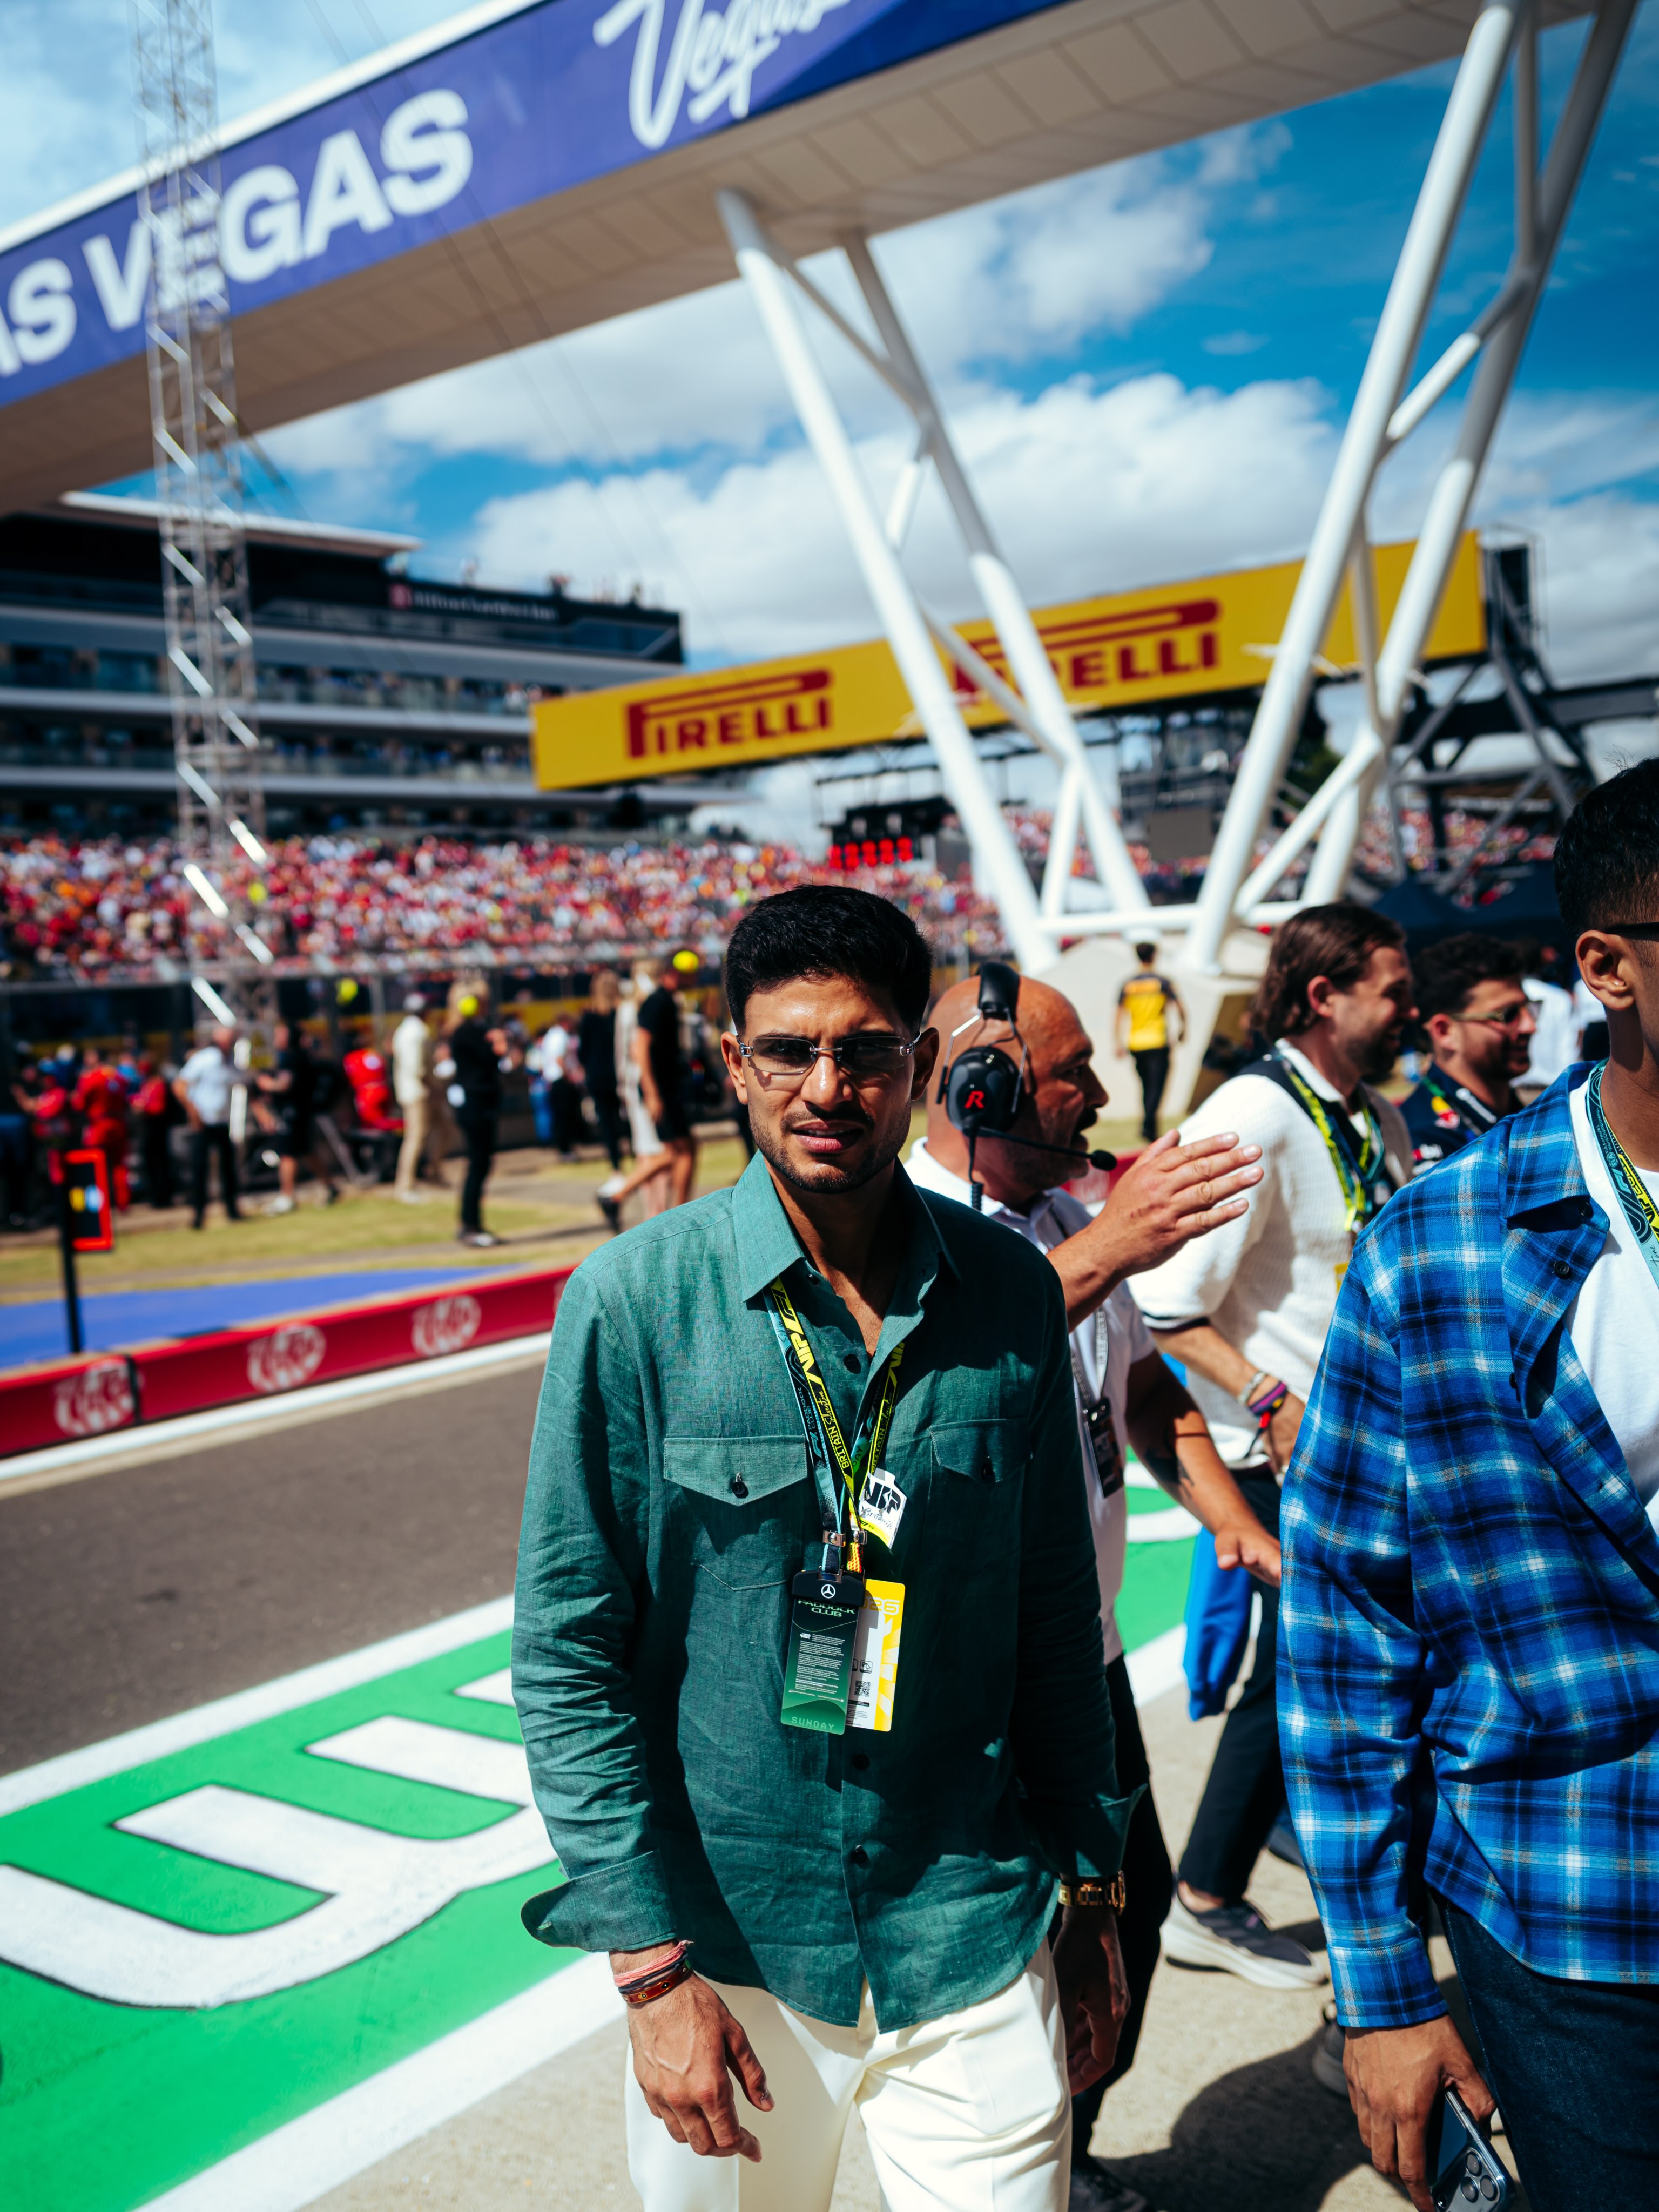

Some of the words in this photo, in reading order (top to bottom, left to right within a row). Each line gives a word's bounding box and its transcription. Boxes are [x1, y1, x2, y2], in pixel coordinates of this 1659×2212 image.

[0, 258, 78, 377] S
[82, 89, 473, 331] VEGAS
[954, 599, 1220, 700] PELLI
[624, 668, 832, 758] PIRELLI
[790, 1332, 815, 1372] VIP
[798, 1387, 812, 1430] PADDOCK
[828, 1426, 850, 1469] BRITAIN
[852, 1446, 864, 1467] DAY
[798, 1599, 855, 1615] PADDOCK
[811, 1607, 842, 1617] CLUB
[862, 1597, 901, 1616] 26
[791, 1716, 835, 1731] SUNDAY
